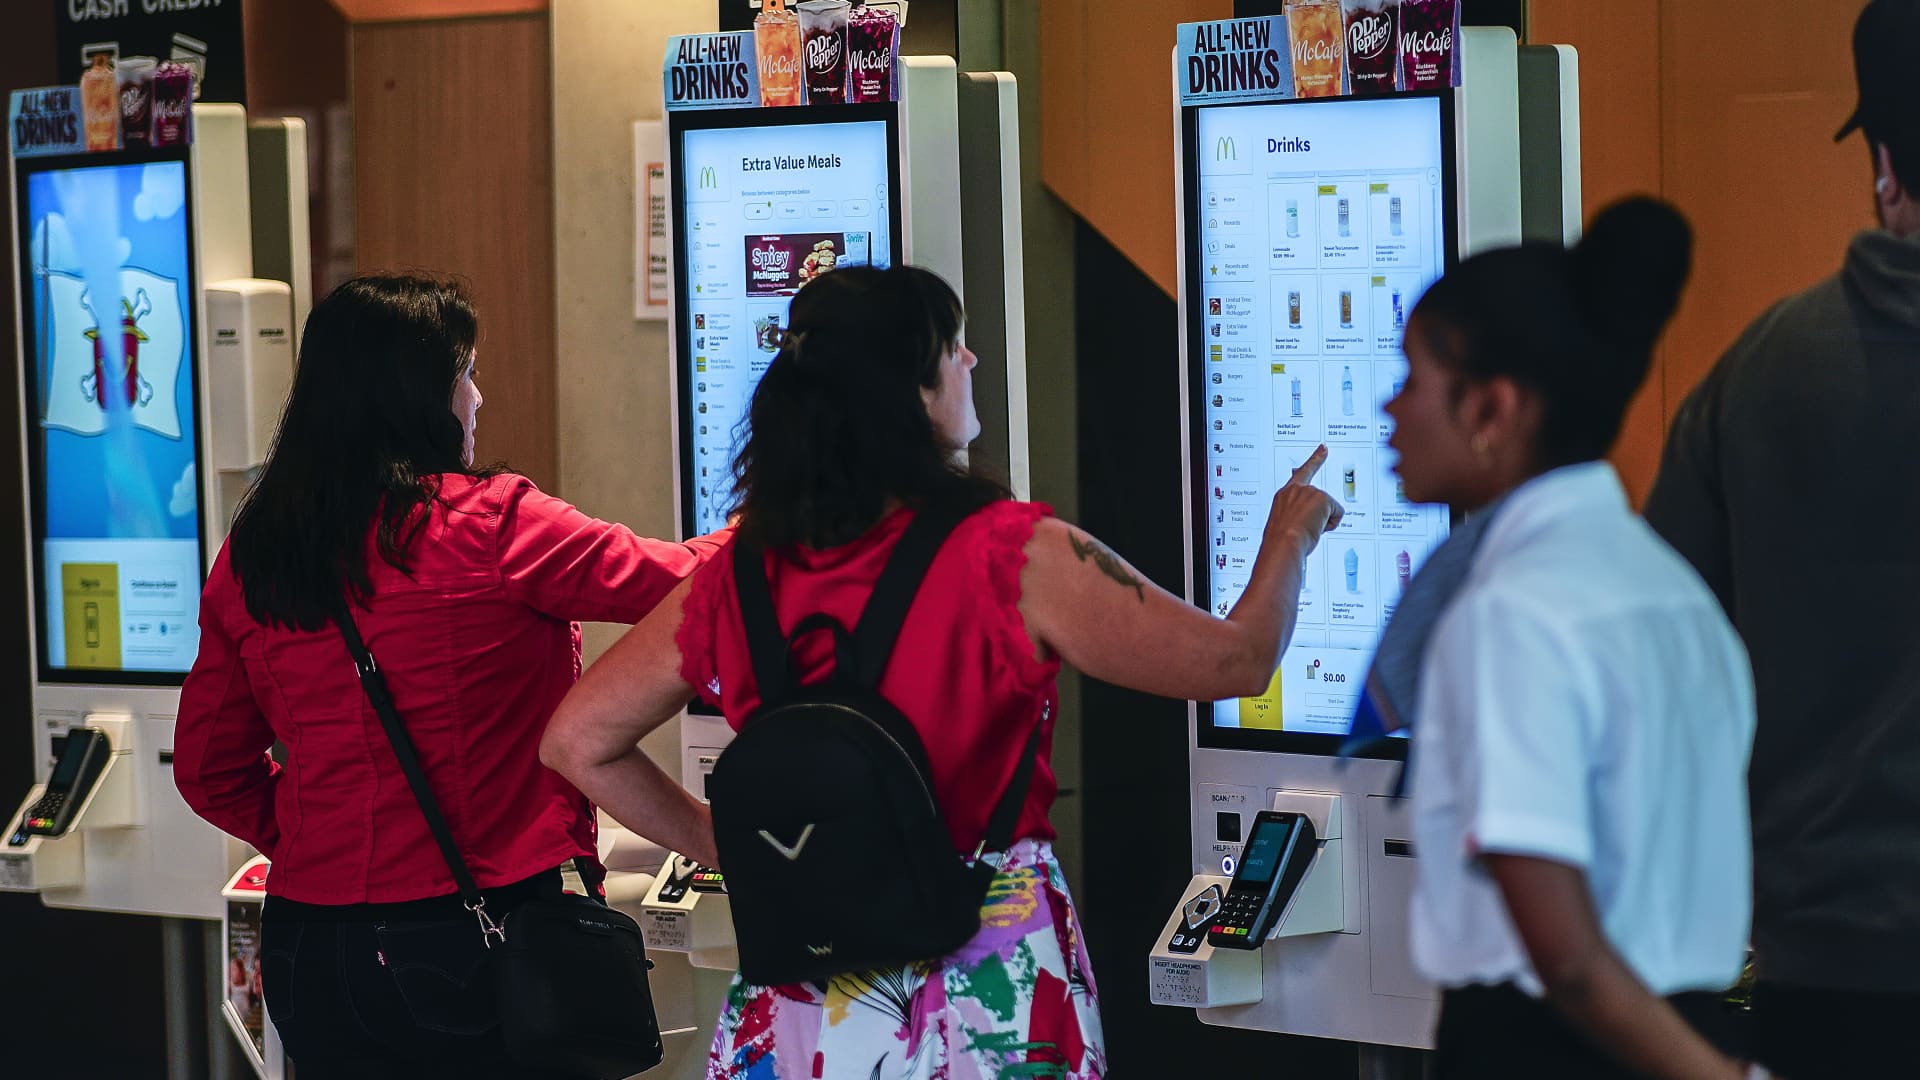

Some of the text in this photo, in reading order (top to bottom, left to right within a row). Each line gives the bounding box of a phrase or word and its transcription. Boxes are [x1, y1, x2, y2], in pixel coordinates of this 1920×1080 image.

[68, 0, 129, 22] CASH
[1195, 20, 1270, 53] ALL-NEW
[1352, 20, 1389, 54] Pepper
[1363, 16, 1379, 37] Dr
[677, 36, 741, 64] ALL-NEW
[808, 39, 839, 69] Pepper
[817, 35, 831, 53] Dr
[1294, 36, 1343, 66] McCafé
[1401, 27, 1451, 58] McCafé
[760, 51, 800, 78] McCafé
[849, 47, 890, 74] McCafé
[1188, 49, 1279, 93] DRINKS
[671, 62, 749, 100] DRINKS
[20, 90, 71, 114] ALL-NEW
[15, 113, 77, 147] DRINKS
[1267, 137, 1311, 153] Drinks
[743, 154, 841, 171] Extra Value Meals
[846, 234, 864, 243] Sprite
[752, 245, 790, 270] Spicy
[753, 271, 790, 281] McNuggets
[1323, 672, 1345, 683] $0.00
[1171, 962, 1201, 970] HEADPHONES
